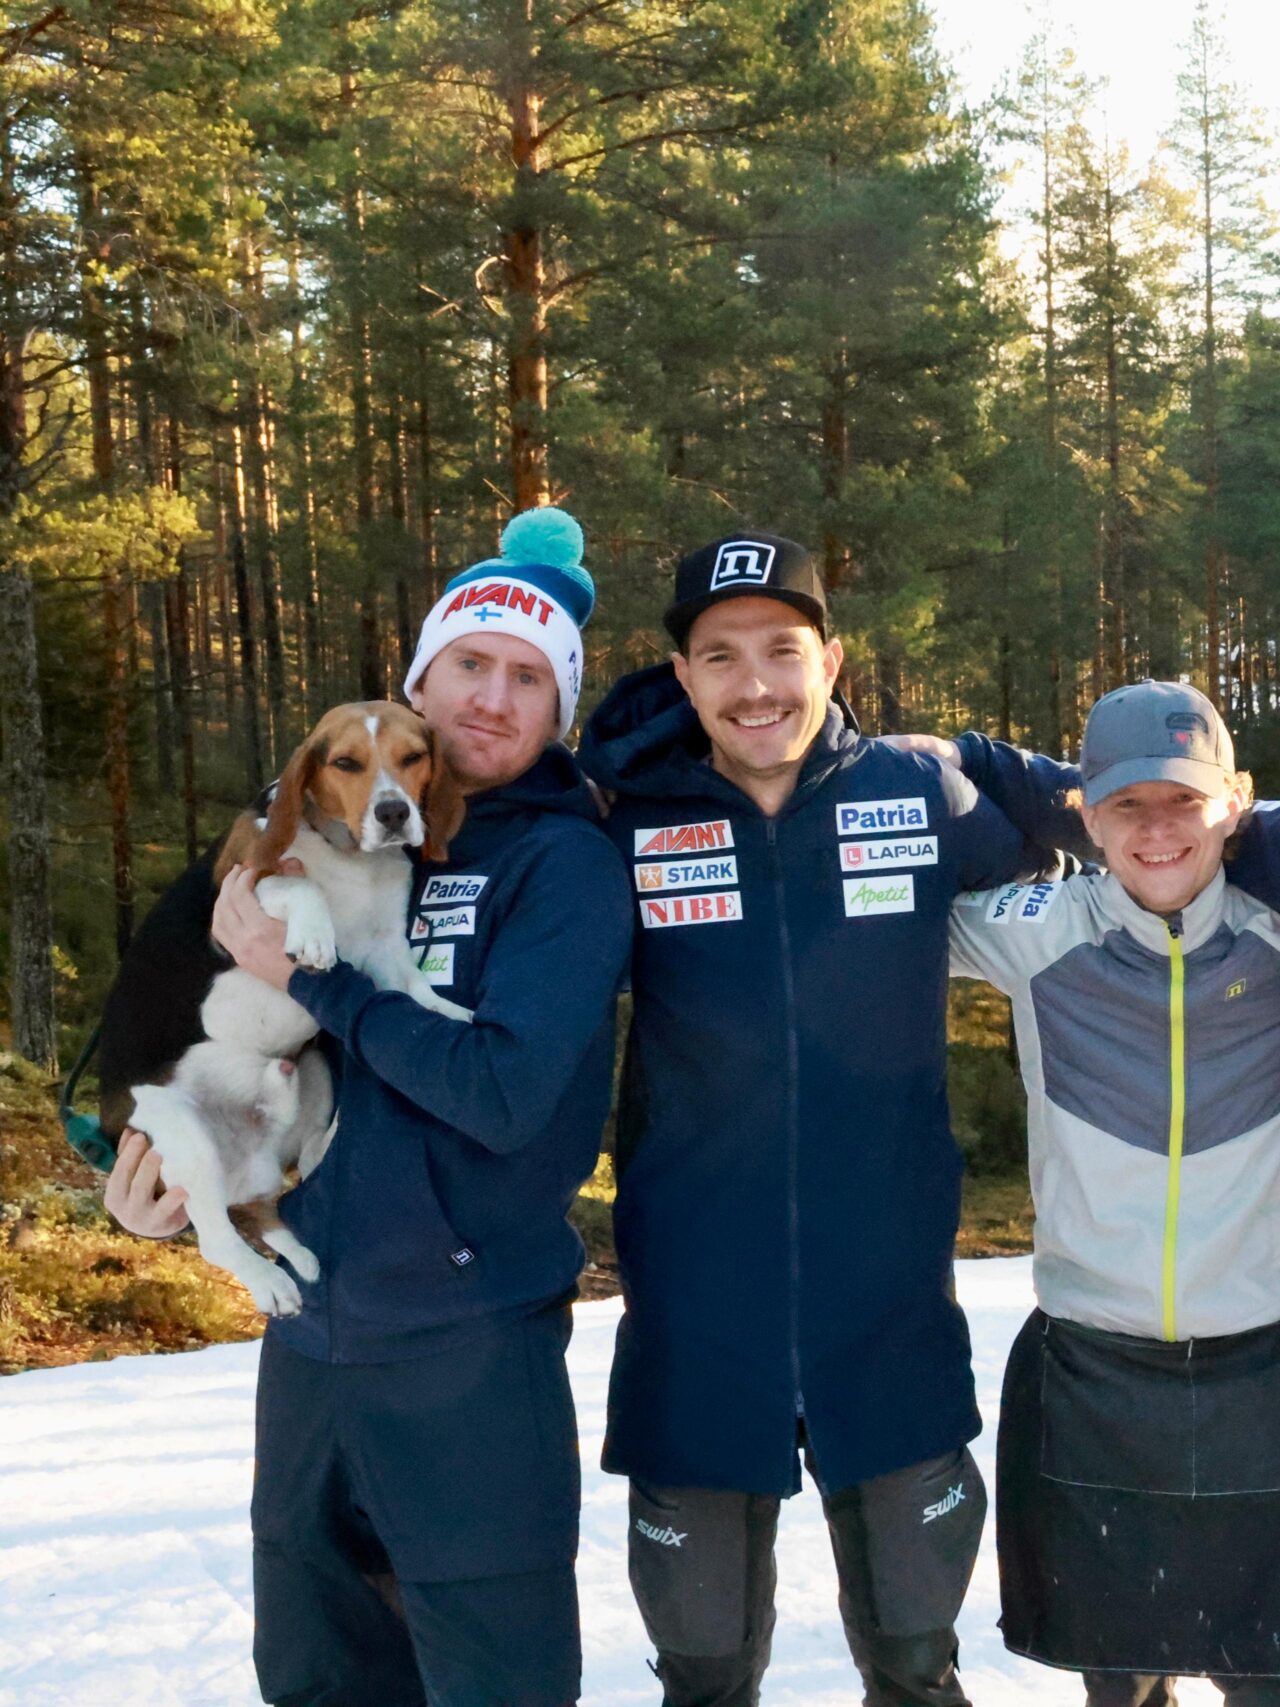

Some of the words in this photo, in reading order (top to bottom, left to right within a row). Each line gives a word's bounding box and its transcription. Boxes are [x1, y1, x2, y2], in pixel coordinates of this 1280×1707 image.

[441, 584, 554, 626] AVANT
[841, 804, 924, 831] Patria
[638, 823, 726, 855] AVANT
[867, 843, 934, 861] LAPUA
[667, 862, 734, 883] STARK
[426, 880, 481, 900] Patria
[850, 883, 908, 912] Apetit
[1022, 881, 1053, 917] tria
[431, 914, 469, 930] LAPUA
[646, 895, 737, 926] NIBE
[417, 956, 449, 974] etit
[922, 1483, 966, 1524] swix
[635, 1518, 688, 1547] swix
